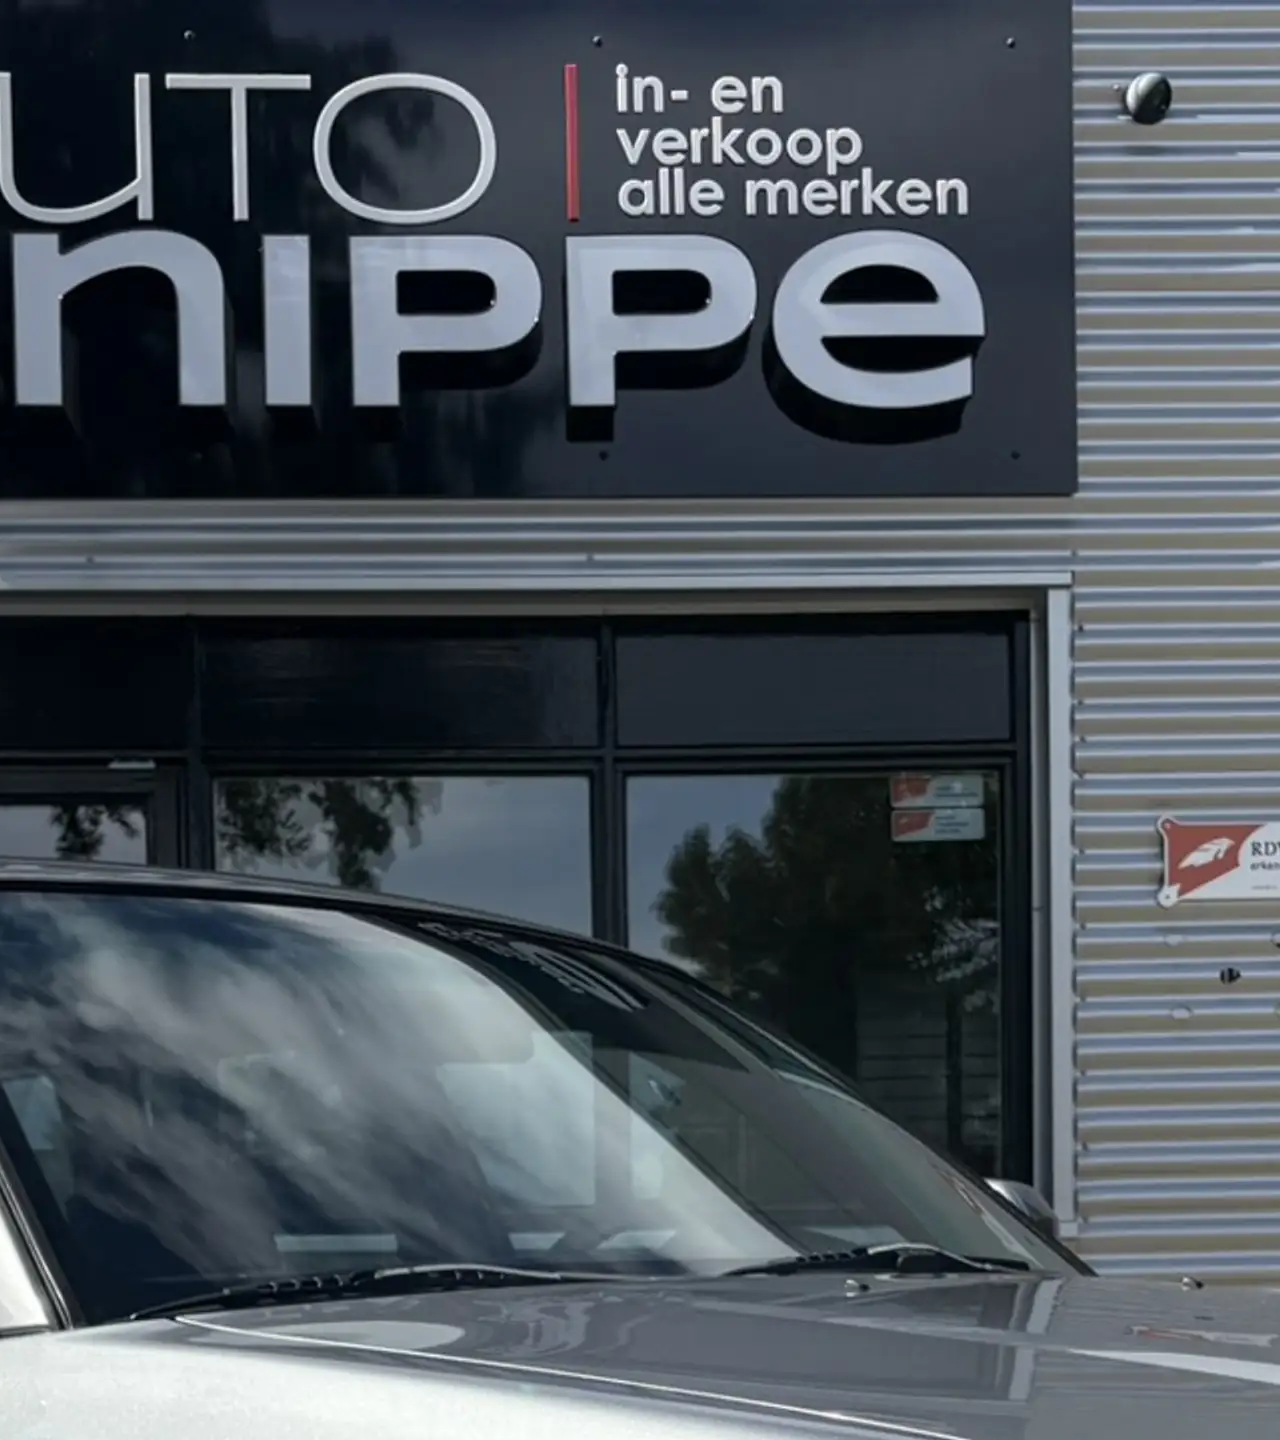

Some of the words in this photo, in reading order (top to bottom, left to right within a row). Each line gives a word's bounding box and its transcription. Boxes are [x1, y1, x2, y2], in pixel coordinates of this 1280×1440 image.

[615, 63, 690, 113] in-
[711, 75, 785, 113] en
[616, 116, 864, 175] verkoop
[618, 167, 724, 216] alle
[745, 167, 970, 216] merken
